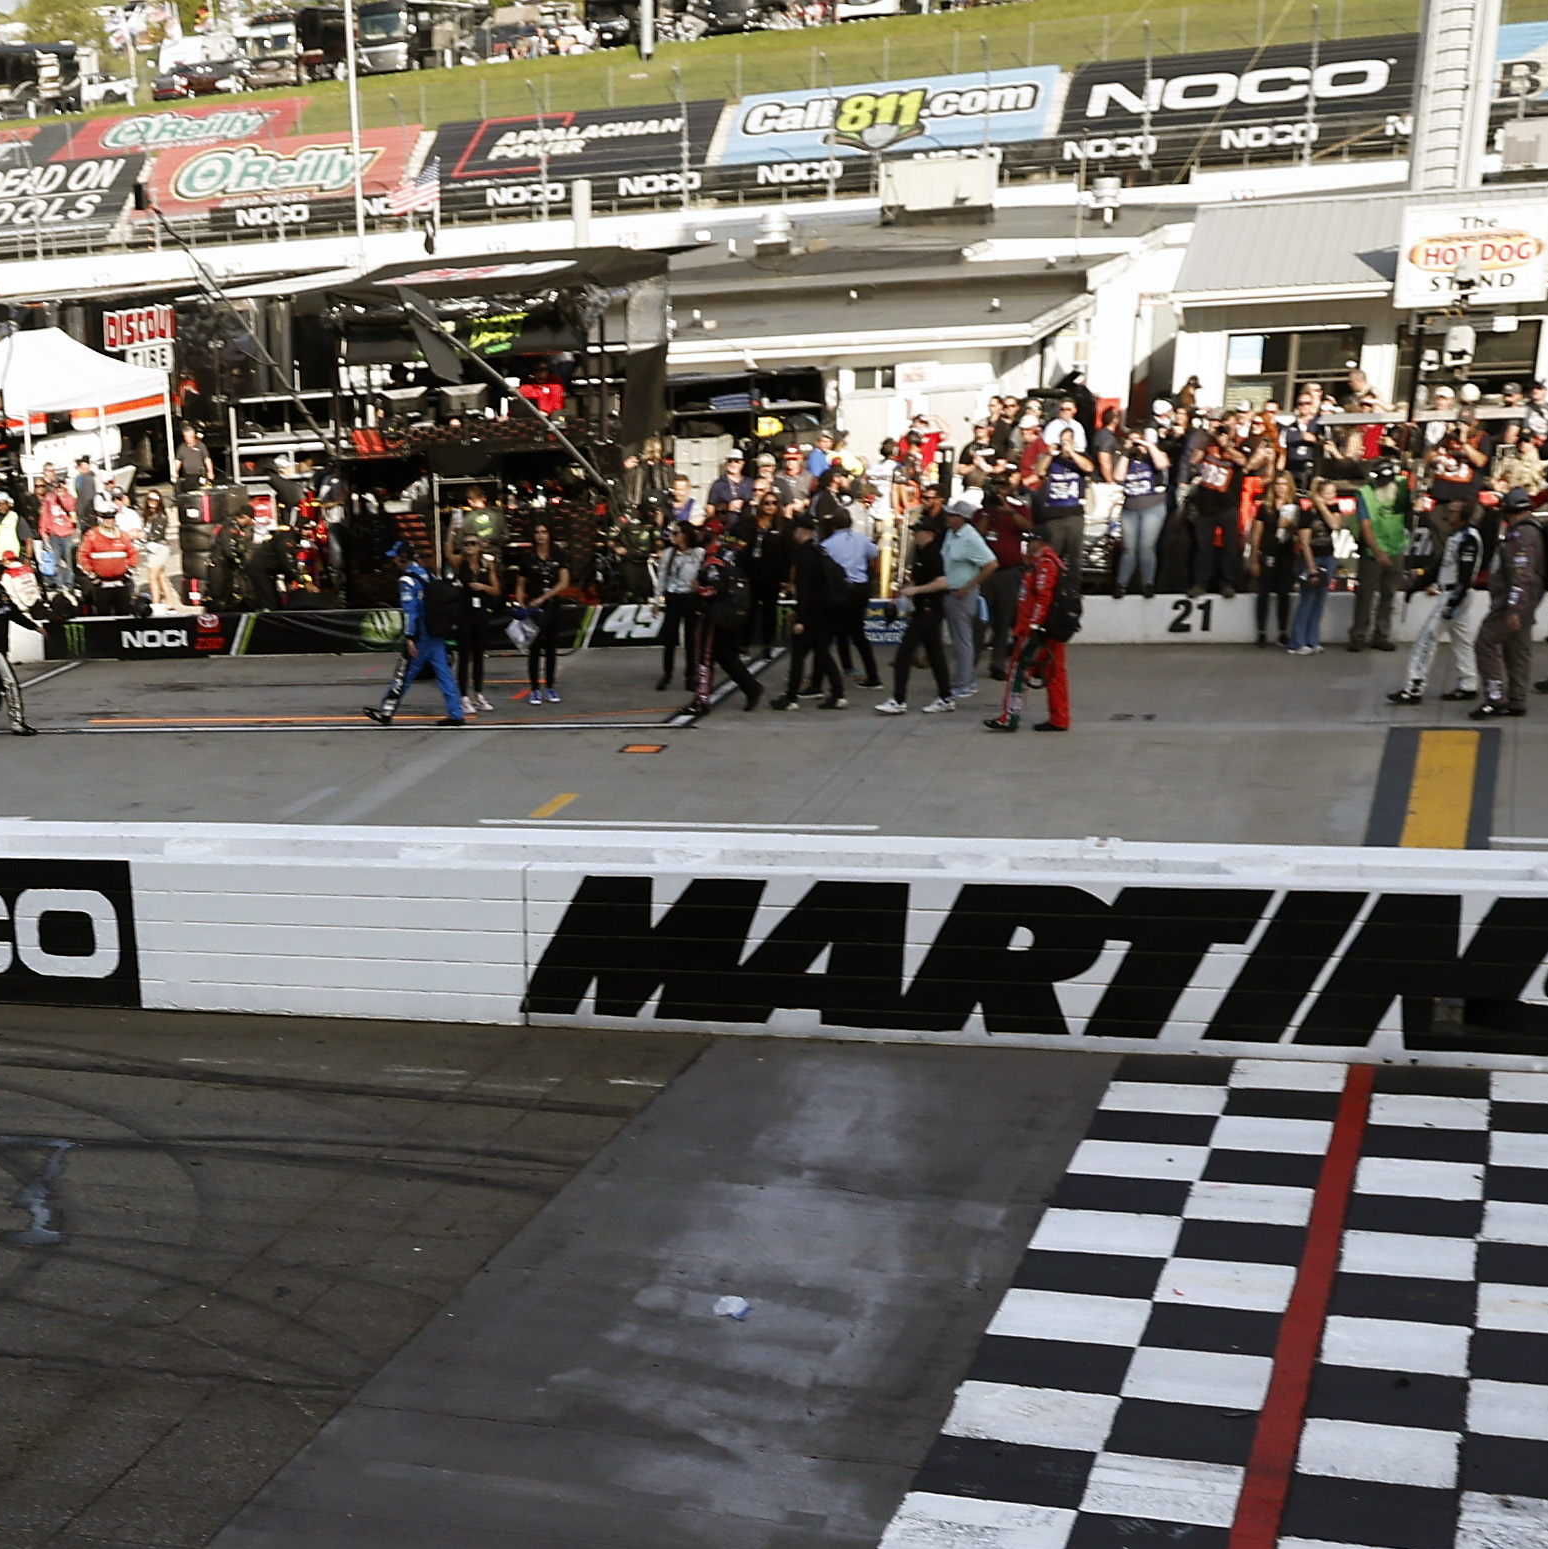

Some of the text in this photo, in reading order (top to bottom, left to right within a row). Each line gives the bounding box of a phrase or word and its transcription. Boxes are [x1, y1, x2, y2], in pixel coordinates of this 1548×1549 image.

[1086, 59, 1391, 118] NOCO
[492, 116, 685, 147] APPALACHIAN
[1221, 123, 1319, 150] NOCO
[487, 139, 590, 164] POWER
[1062, 135, 1157, 160] NOCO
[66, 158, 126, 192] ON
[179, 148, 373, 197] O'Reilly
[618, 170, 702, 197] NOCO
[756, 159, 844, 186] NOCO
[486, 182, 567, 207] NOCO
[235, 203, 310, 227] NOCO
[1459, 216, 1500, 230] The
[1424, 241, 1533, 266] HOT DOG
[1429, 273, 1516, 292] STND
[1168, 599, 1212, 633] 21
